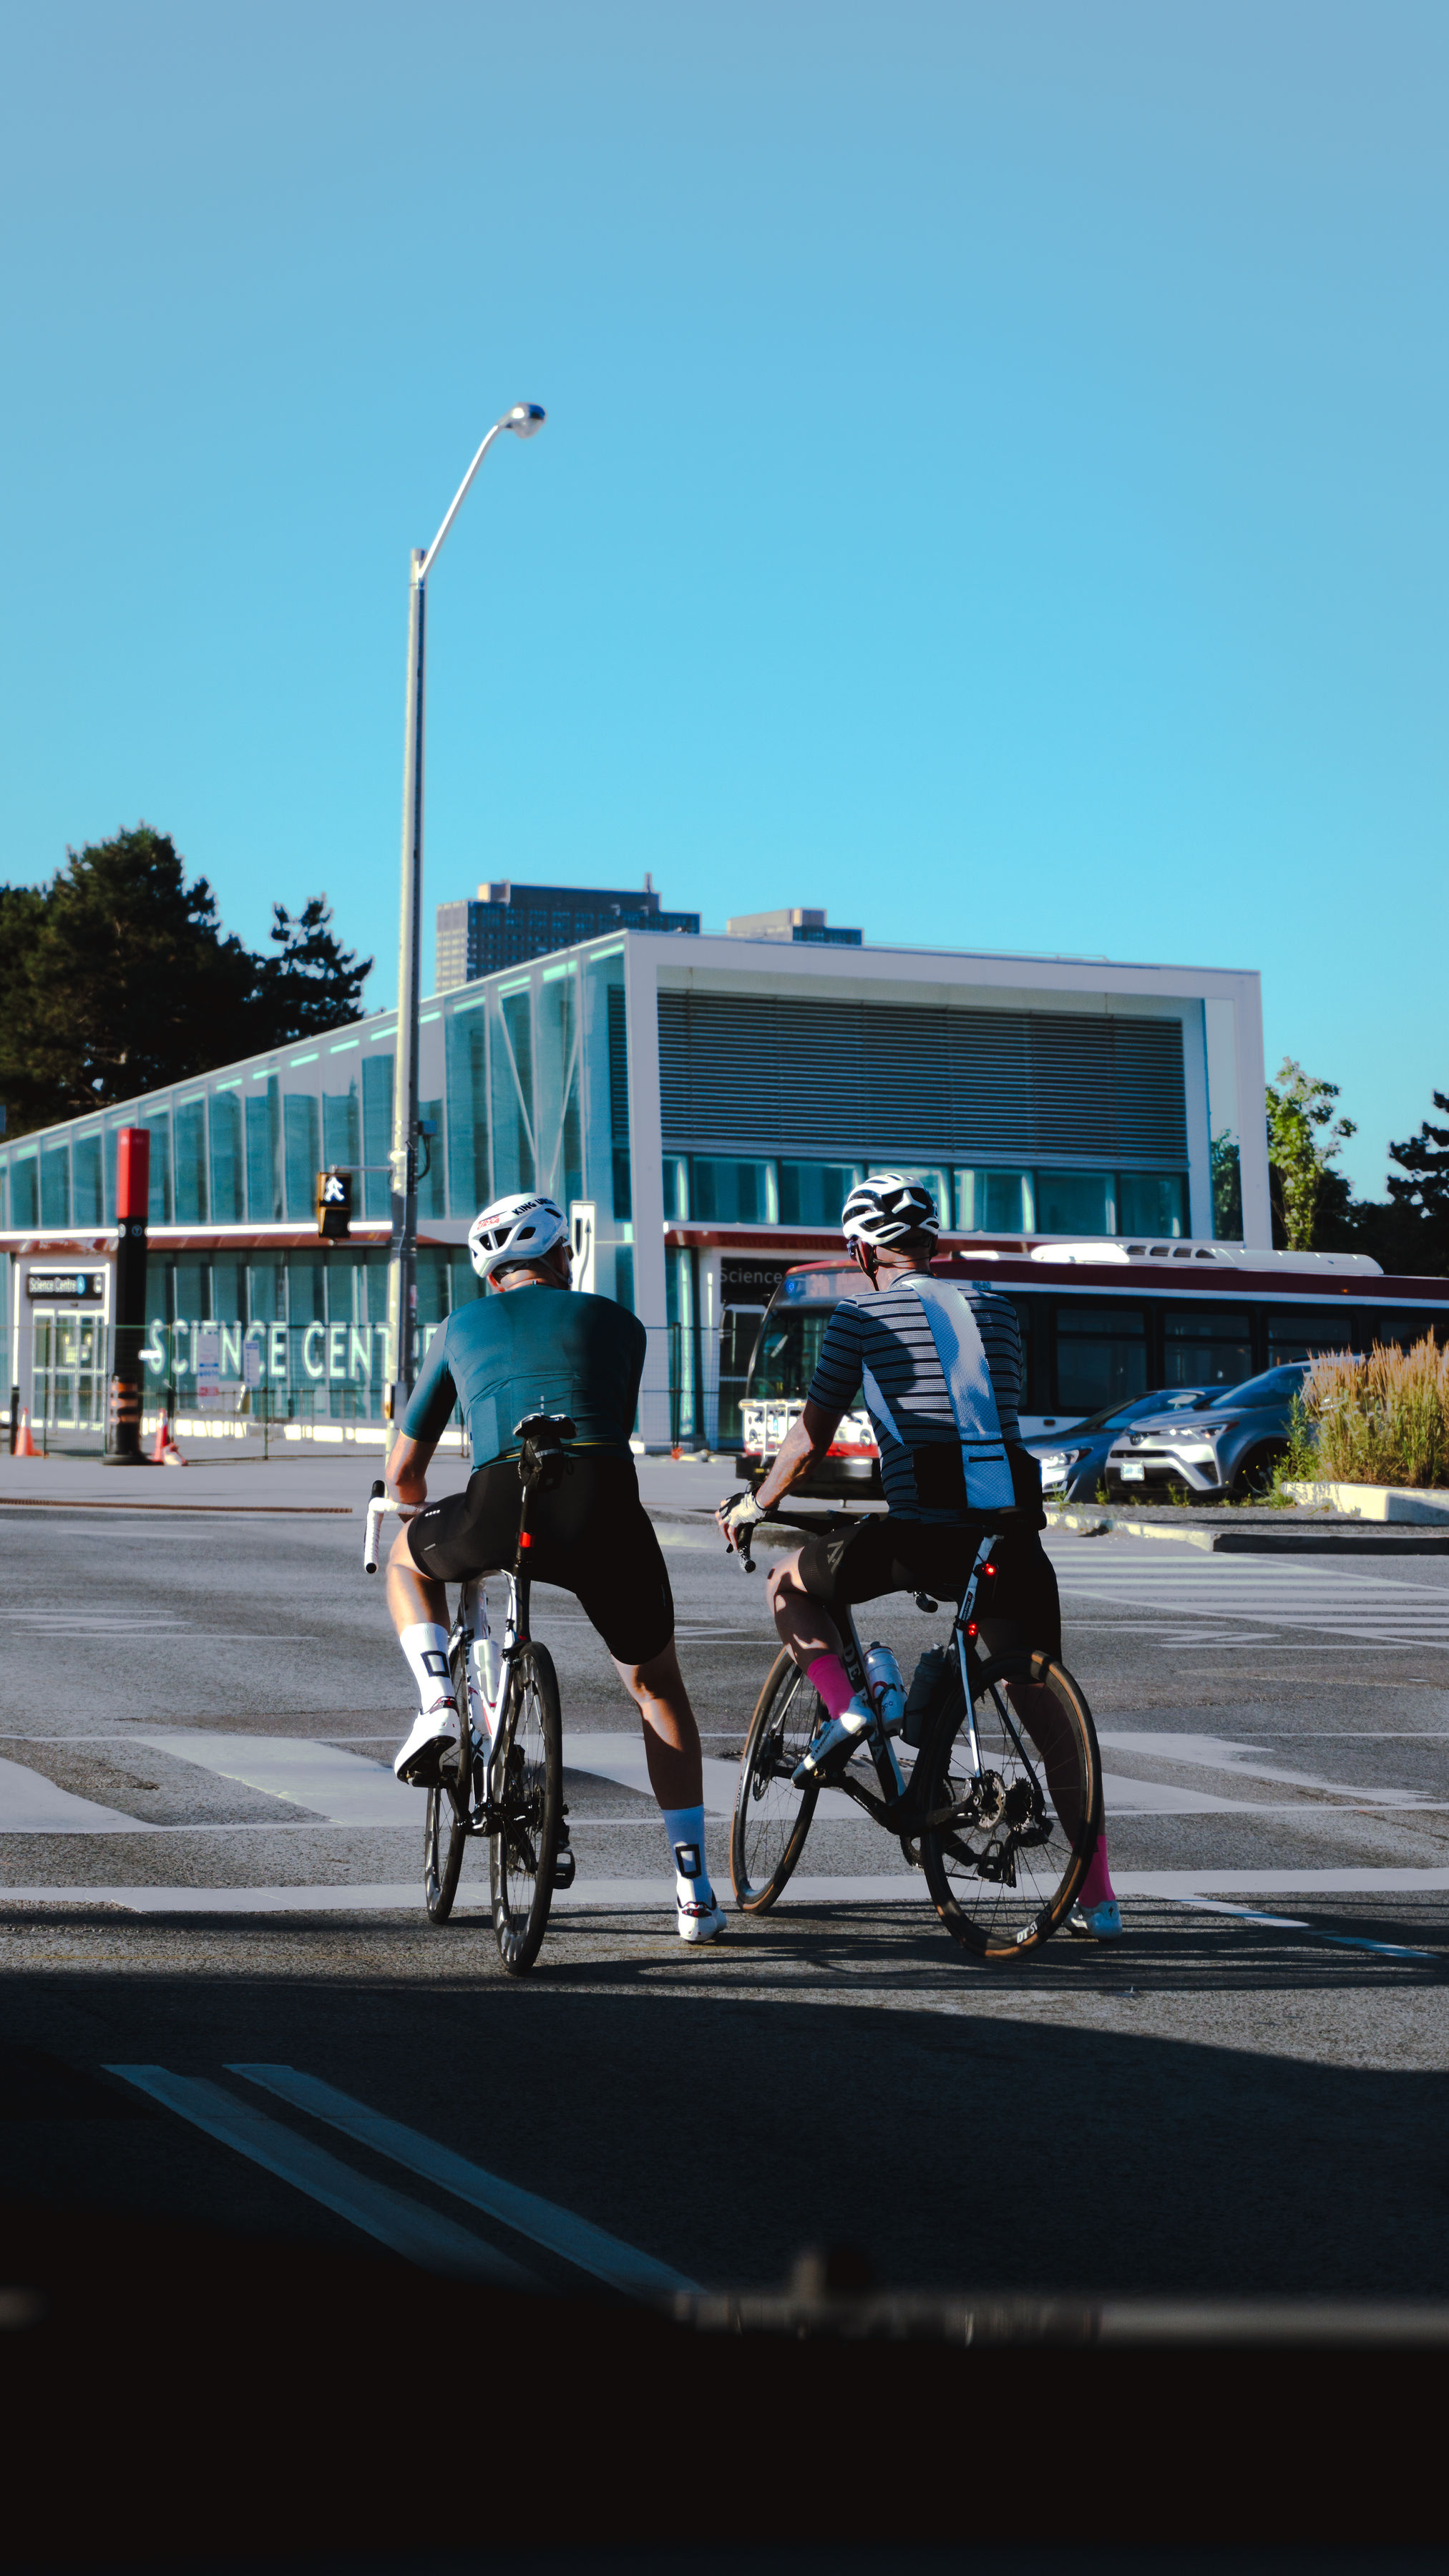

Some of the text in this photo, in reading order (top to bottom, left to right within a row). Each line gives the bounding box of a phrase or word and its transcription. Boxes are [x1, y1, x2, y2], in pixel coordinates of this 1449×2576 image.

[512, 1202, 537, 1216] KING
[721, 1268, 782, 1283] Science
[29, 1277, 54, 1292] Science
[150, 1319, 288, 1375] SCINCE
[302, 1321, 441, 1379] CENT
